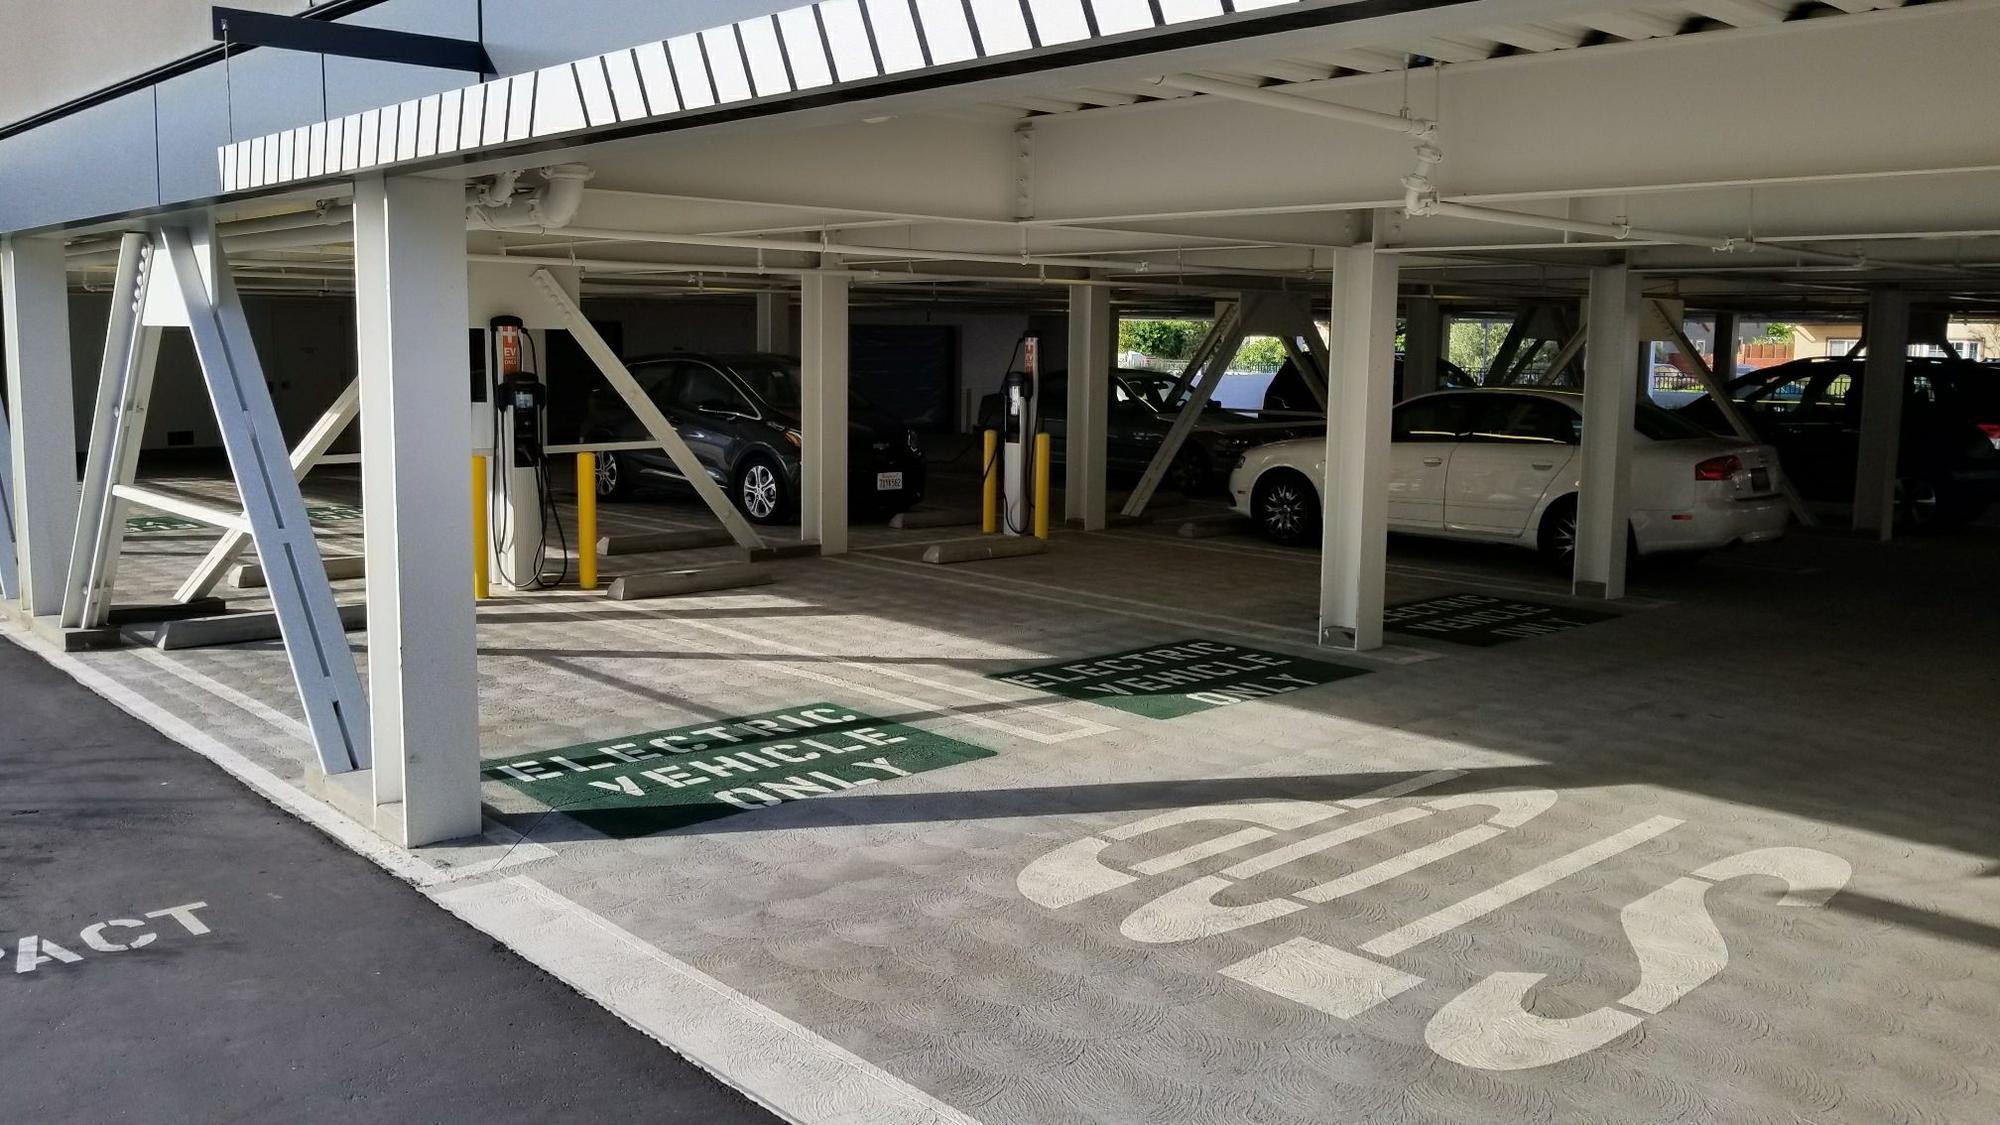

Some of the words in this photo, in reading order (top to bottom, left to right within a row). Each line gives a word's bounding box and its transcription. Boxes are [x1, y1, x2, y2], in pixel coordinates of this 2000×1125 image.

[504, 347, 517, 358] EV
[998, 641, 1237, 689] ELECTRIC
[1083, 654, 1293, 697] VEHICLE
[1185, 672, 1319, 706] ONLY
[496, 707, 858, 783] ELECTRIC
[587, 727, 909, 797] VEHICLE
[713, 757, 913, 811] ONLY
[0, 901, 211, 974] ACT
[1016, 768, 1853, 1072] STOP
